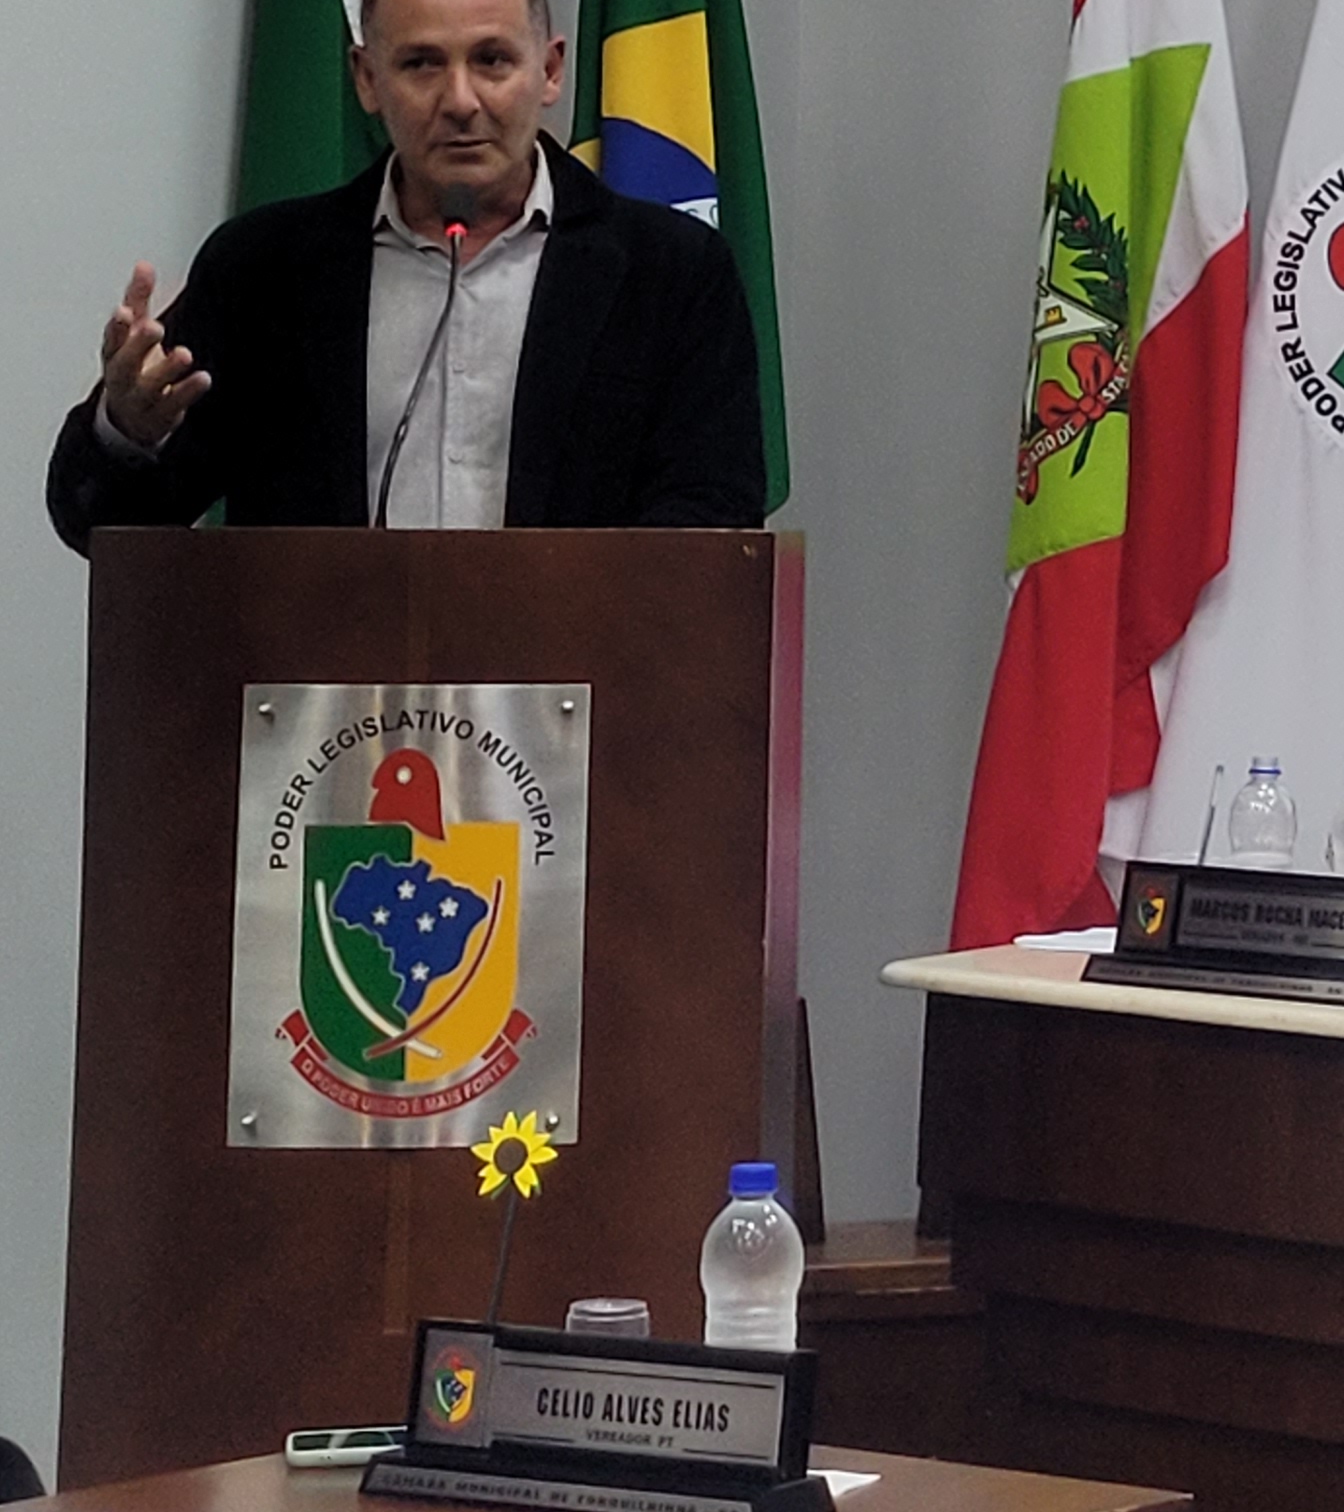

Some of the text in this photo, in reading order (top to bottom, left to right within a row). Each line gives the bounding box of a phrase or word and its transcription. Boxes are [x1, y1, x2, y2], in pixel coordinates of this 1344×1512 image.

[269, 708, 556, 870] PODER LEGISLATIVO MUNICIPAL
[537, 1387, 730, 1433] CELIO ALVES ELIAS
